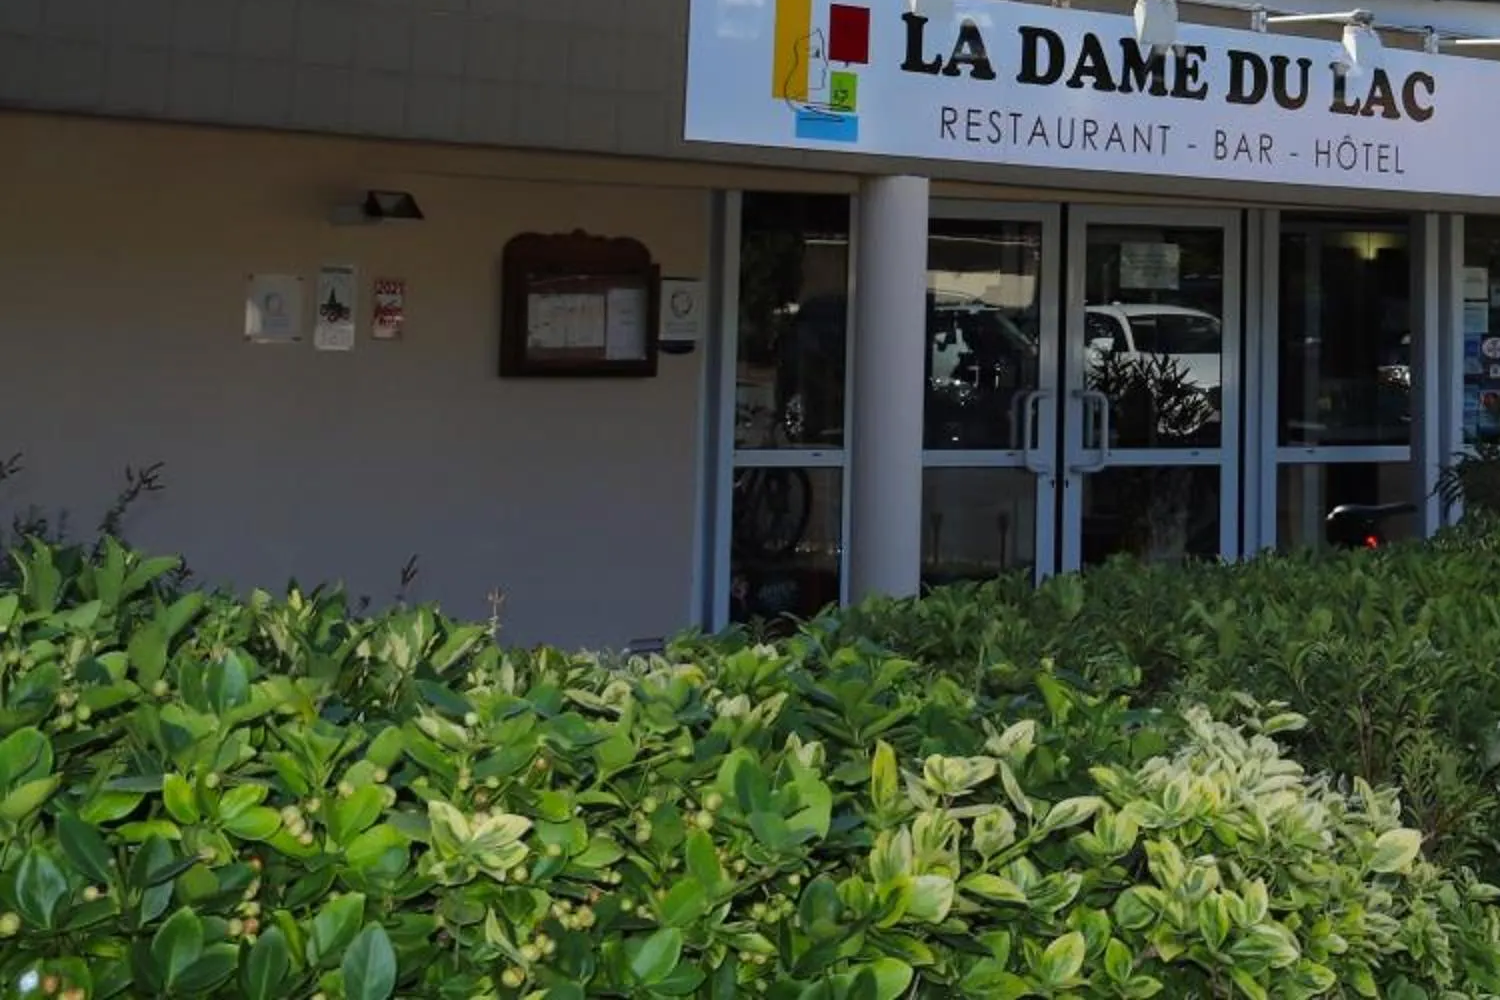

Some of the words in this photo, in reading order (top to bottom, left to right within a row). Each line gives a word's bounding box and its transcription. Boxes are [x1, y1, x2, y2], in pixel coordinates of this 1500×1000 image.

[900, 11, 997, 81] LA
[1015, 25, 1209, 101] DAME
[1225, 49, 1313, 111] DU
[1328, 60, 1436, 123] LAC
[940, 105, 1172, 156] RESTAURANT
[1213, 128, 1274, 165] BAR
[1314, 135, 1406, 174] HÔTEL
